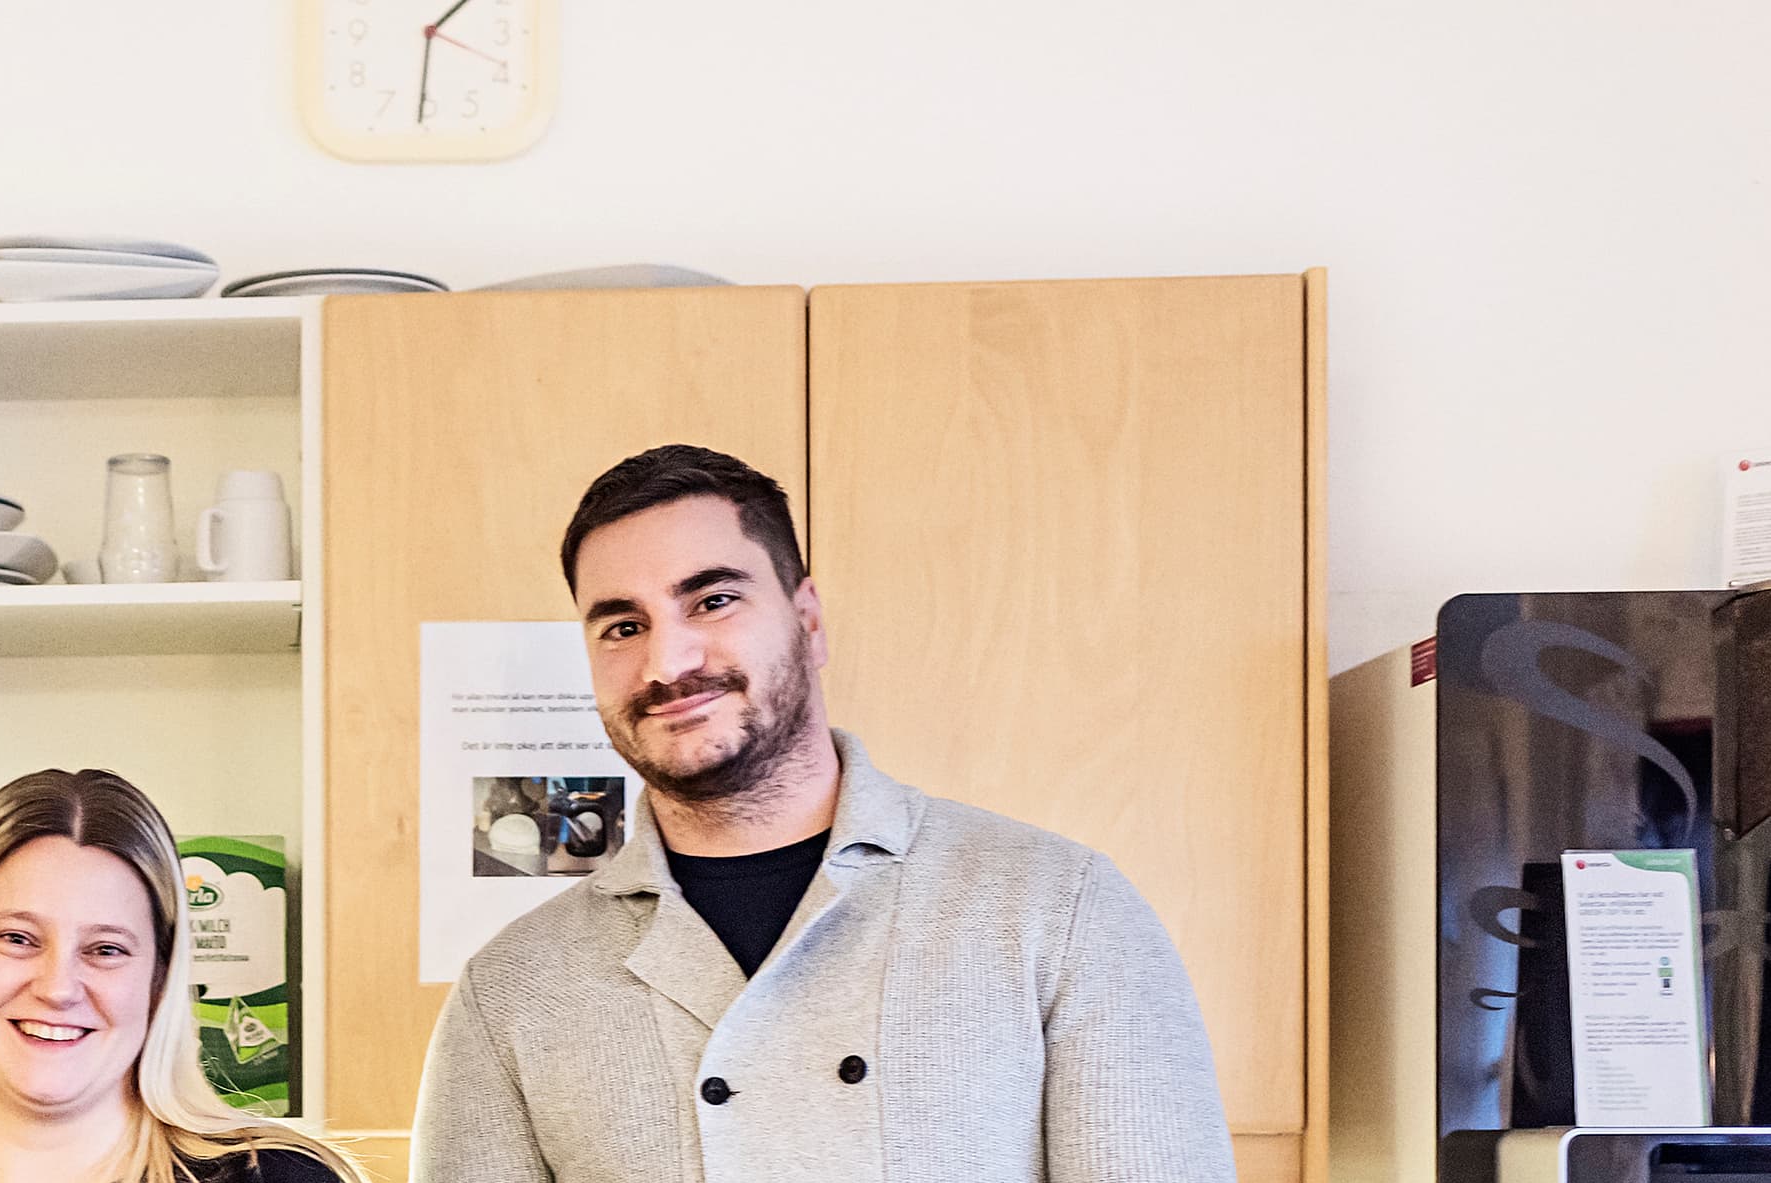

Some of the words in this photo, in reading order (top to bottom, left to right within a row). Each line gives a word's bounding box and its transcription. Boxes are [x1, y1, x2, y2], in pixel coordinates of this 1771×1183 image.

[347, 18, 368, 46] 9
[493, 18, 510, 46] 3
[349, 61, 366, 88] 8
[376, 89, 396, 118] 7
[461, 89, 479, 118] 5
